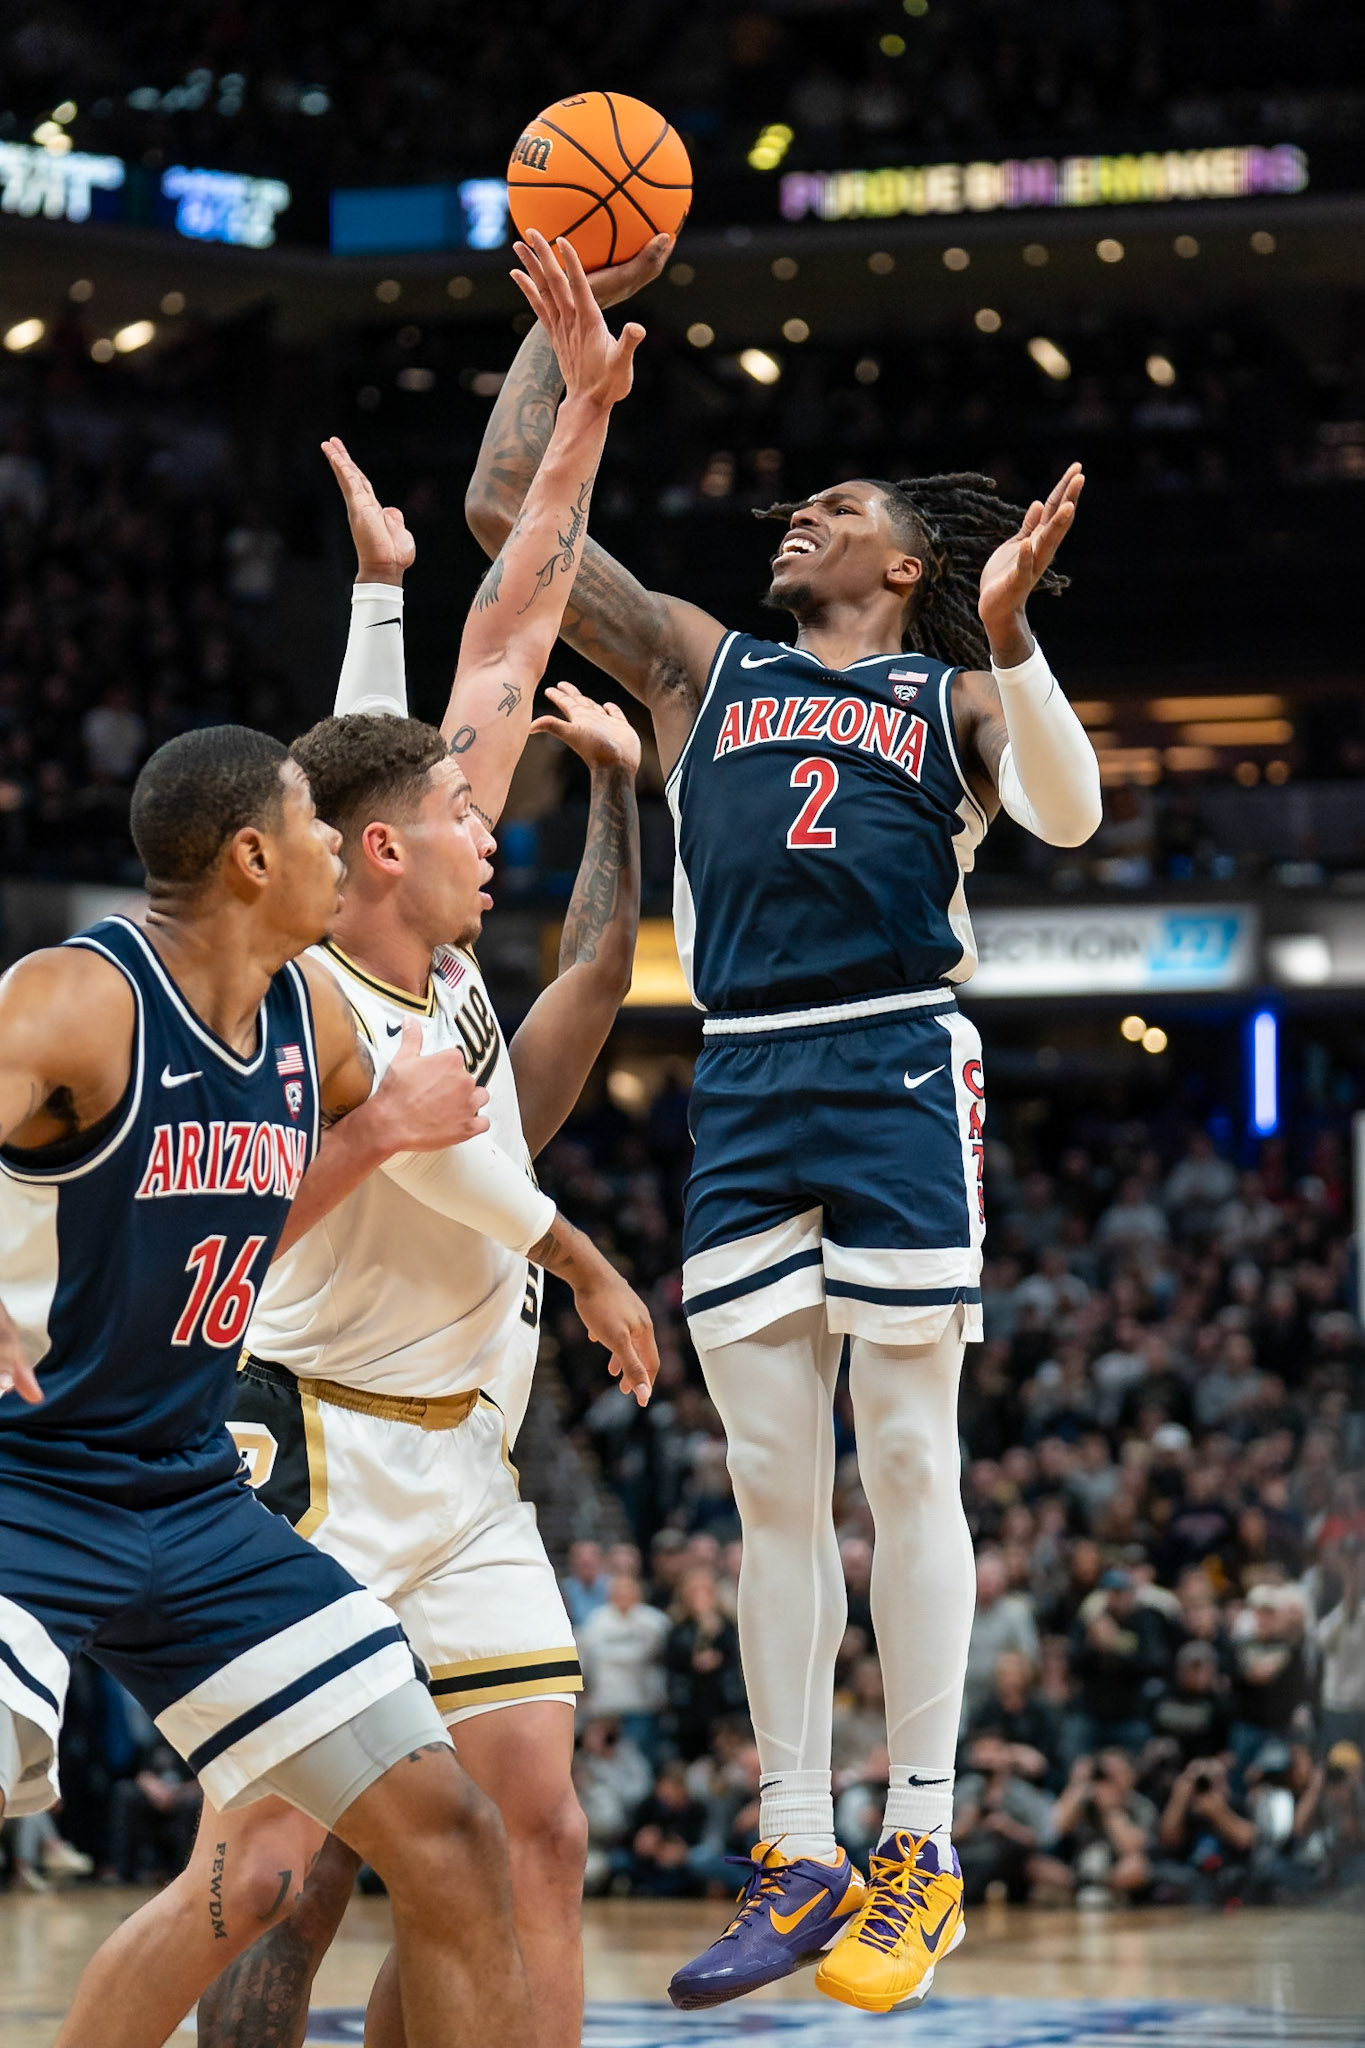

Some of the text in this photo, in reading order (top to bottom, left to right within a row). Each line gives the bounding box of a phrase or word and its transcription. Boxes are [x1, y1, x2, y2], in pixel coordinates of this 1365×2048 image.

[713, 696, 929, 784] ARIZONA
[786, 757, 840, 850] 2
[170, 1234, 267, 1350] 16
[208, 1841, 228, 1940] FEWDM
